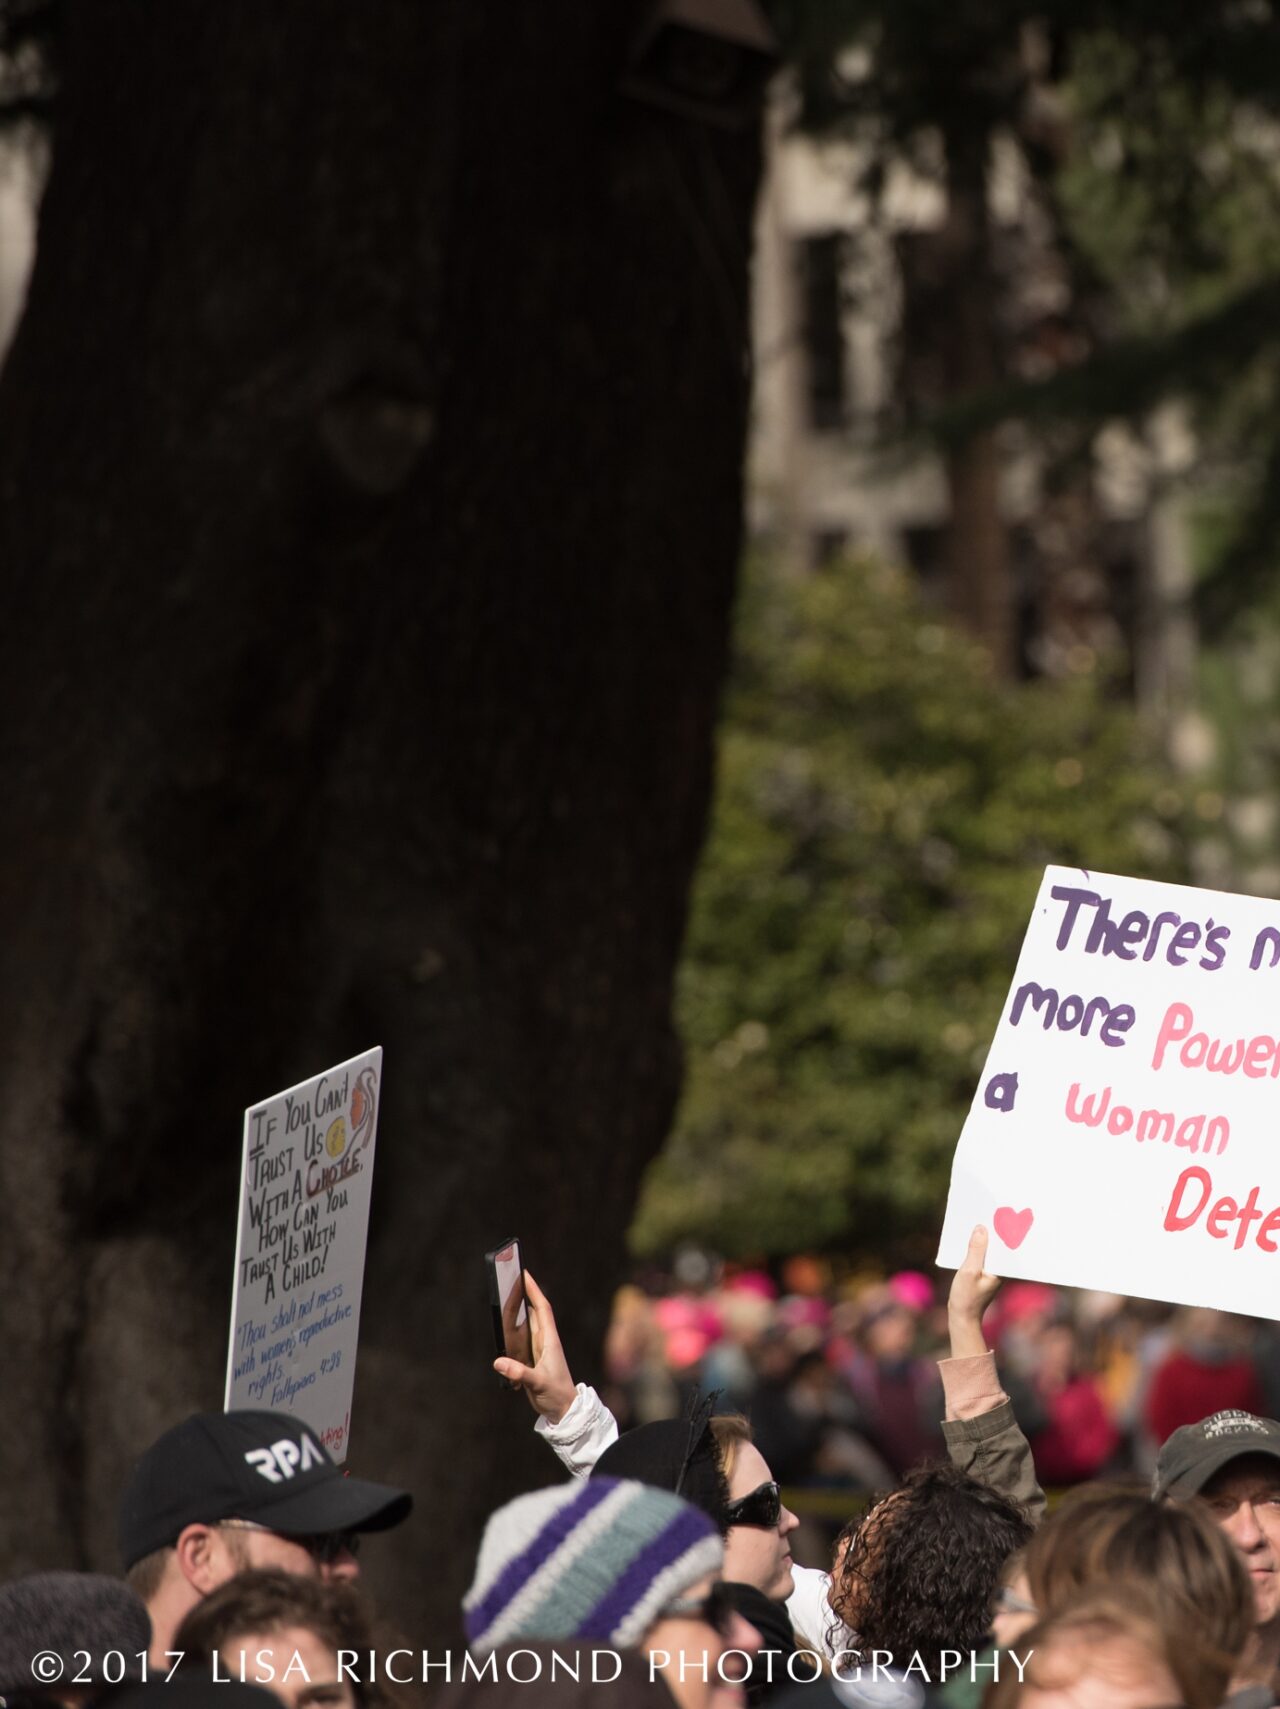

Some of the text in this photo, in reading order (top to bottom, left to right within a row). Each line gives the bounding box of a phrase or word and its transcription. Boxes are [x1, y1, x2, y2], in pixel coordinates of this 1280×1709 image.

[1050, 885, 1231, 971] There's
[1008, 981, 1136, 1047] more
[983, 1072, 1019, 1112] a
[264, 1272, 276, 1305] A
